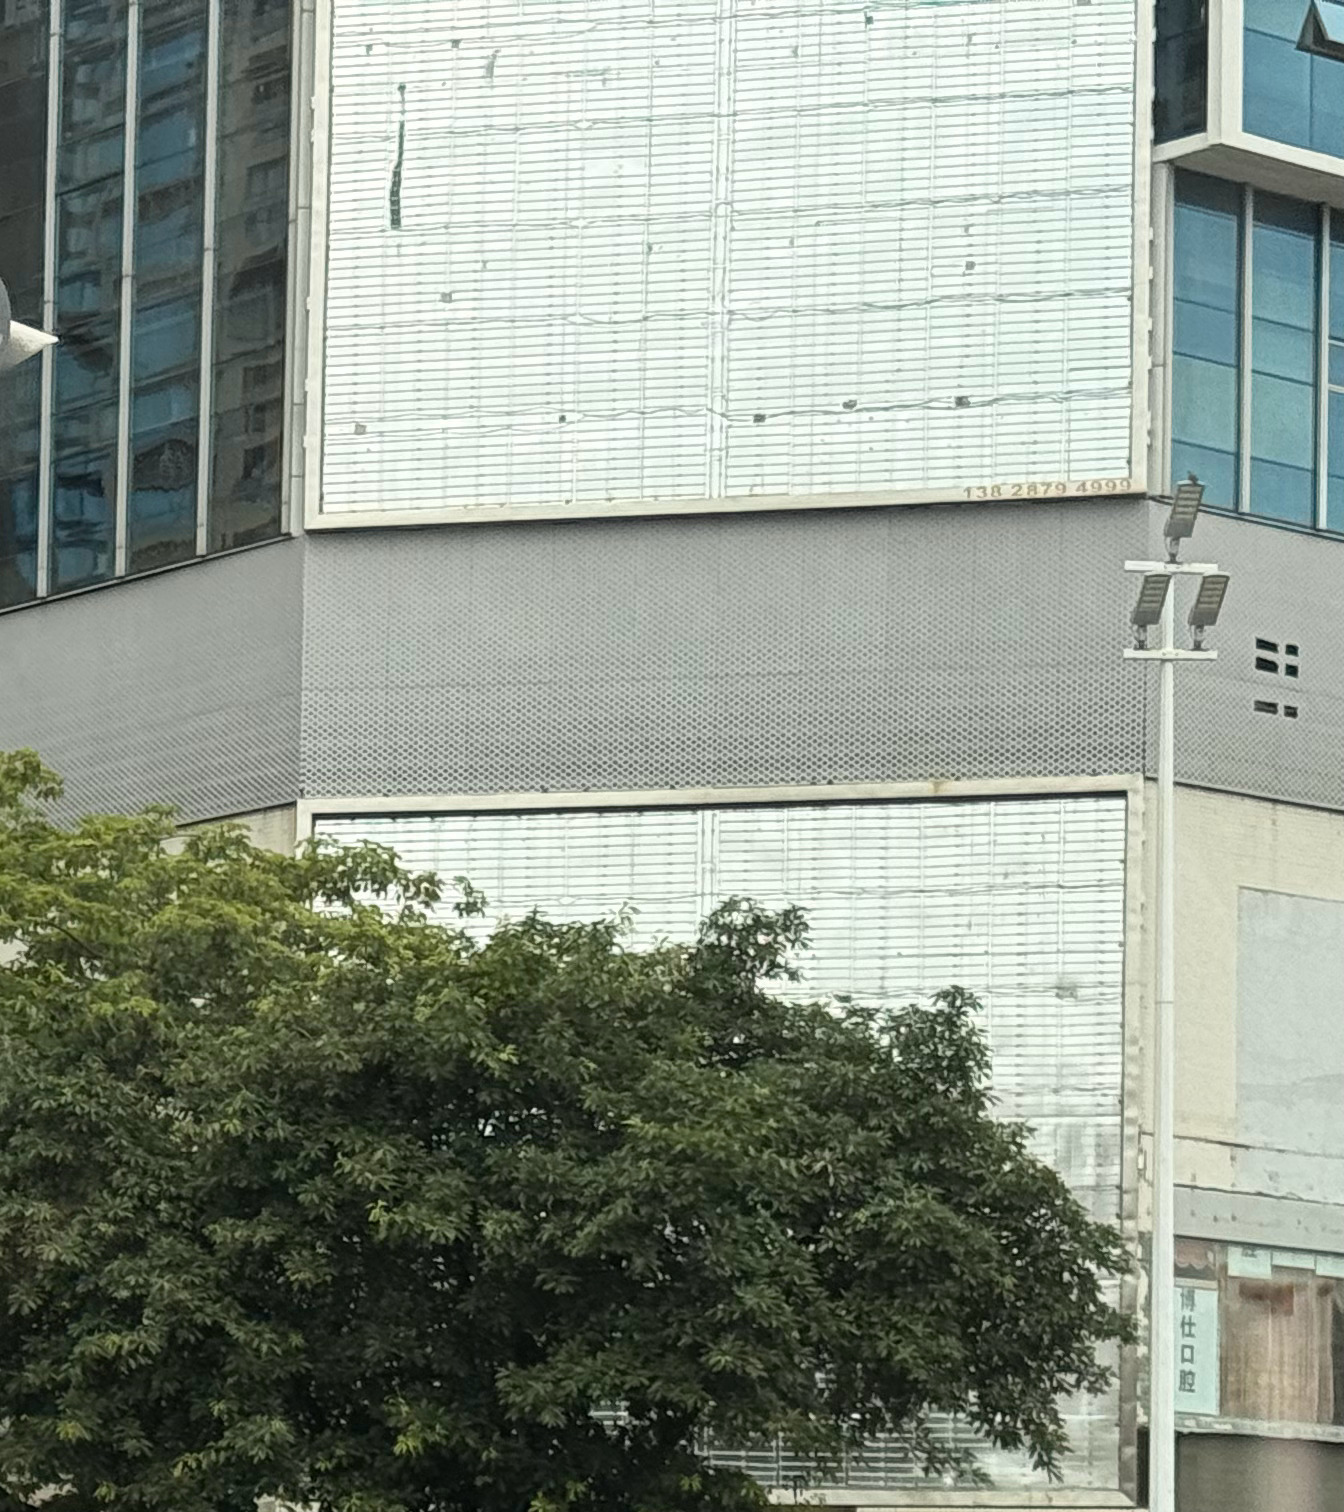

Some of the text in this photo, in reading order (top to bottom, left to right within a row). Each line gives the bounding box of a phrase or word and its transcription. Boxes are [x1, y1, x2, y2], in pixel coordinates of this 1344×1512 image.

[963, 478, 1132, 499] 138 2879 4999
